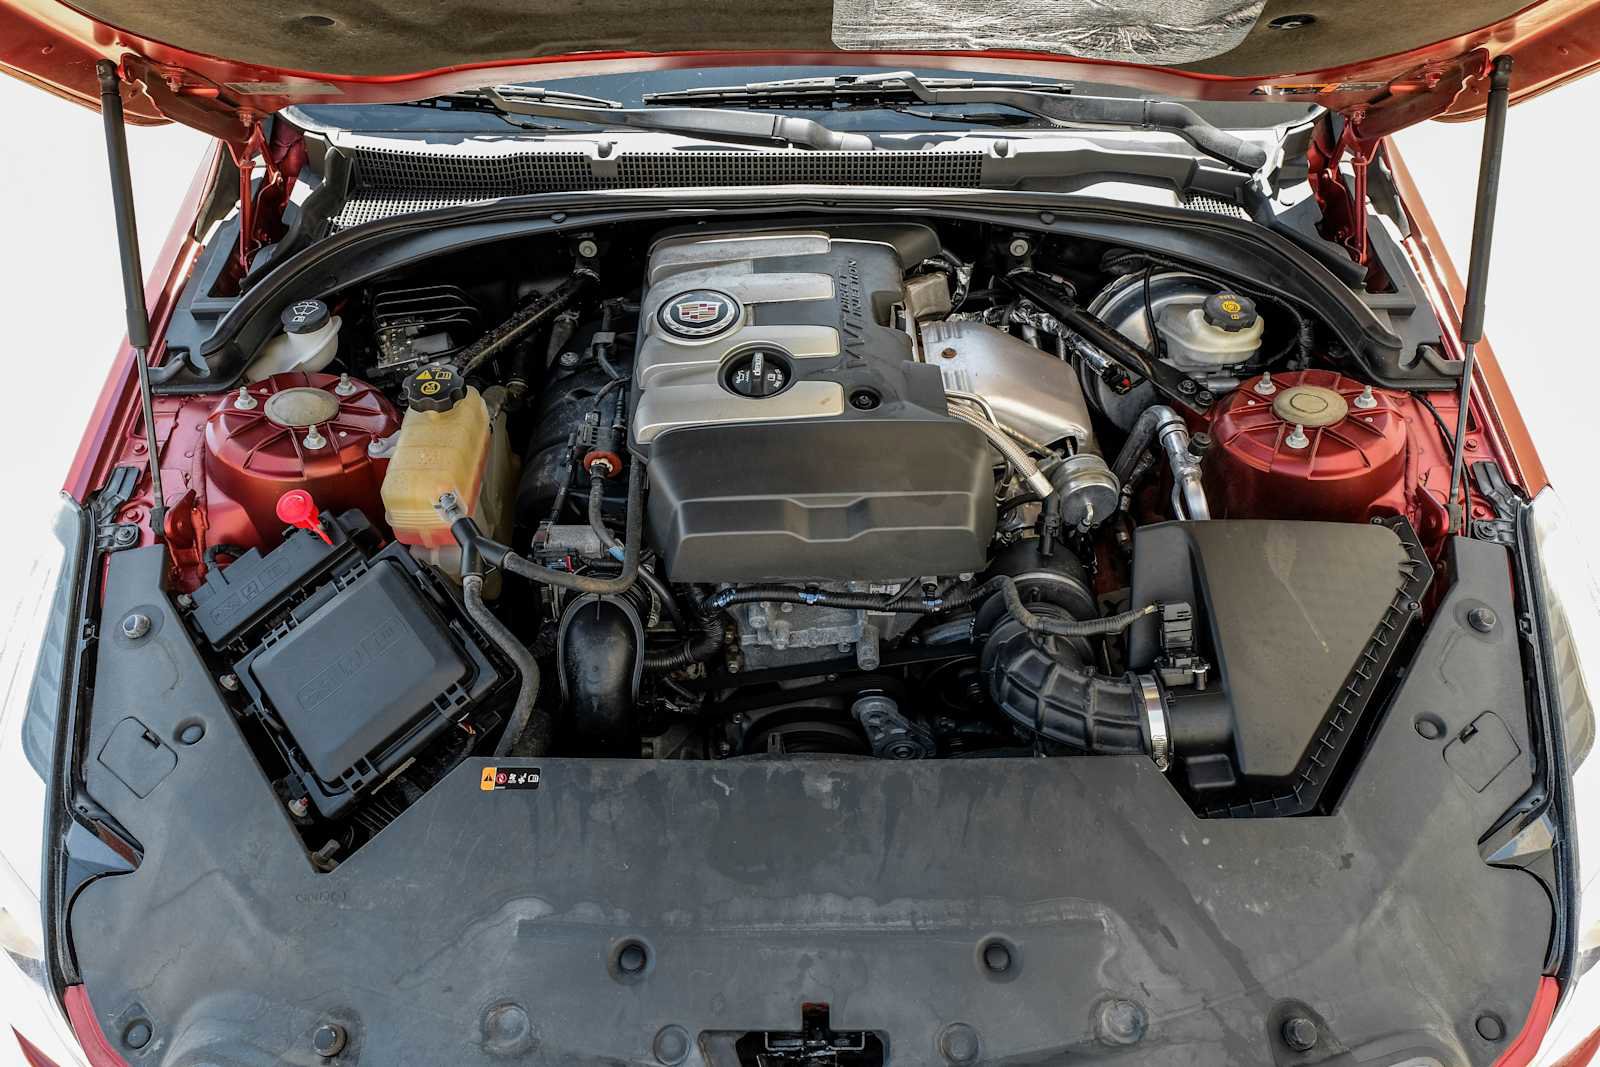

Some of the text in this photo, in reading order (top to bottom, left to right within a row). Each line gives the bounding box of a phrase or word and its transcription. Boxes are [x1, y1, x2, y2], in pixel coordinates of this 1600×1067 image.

[839, 273, 850, 313] DIRECT
[847, 259, 862, 317] INJECTION
[842, 313, 867, 369] VVT
